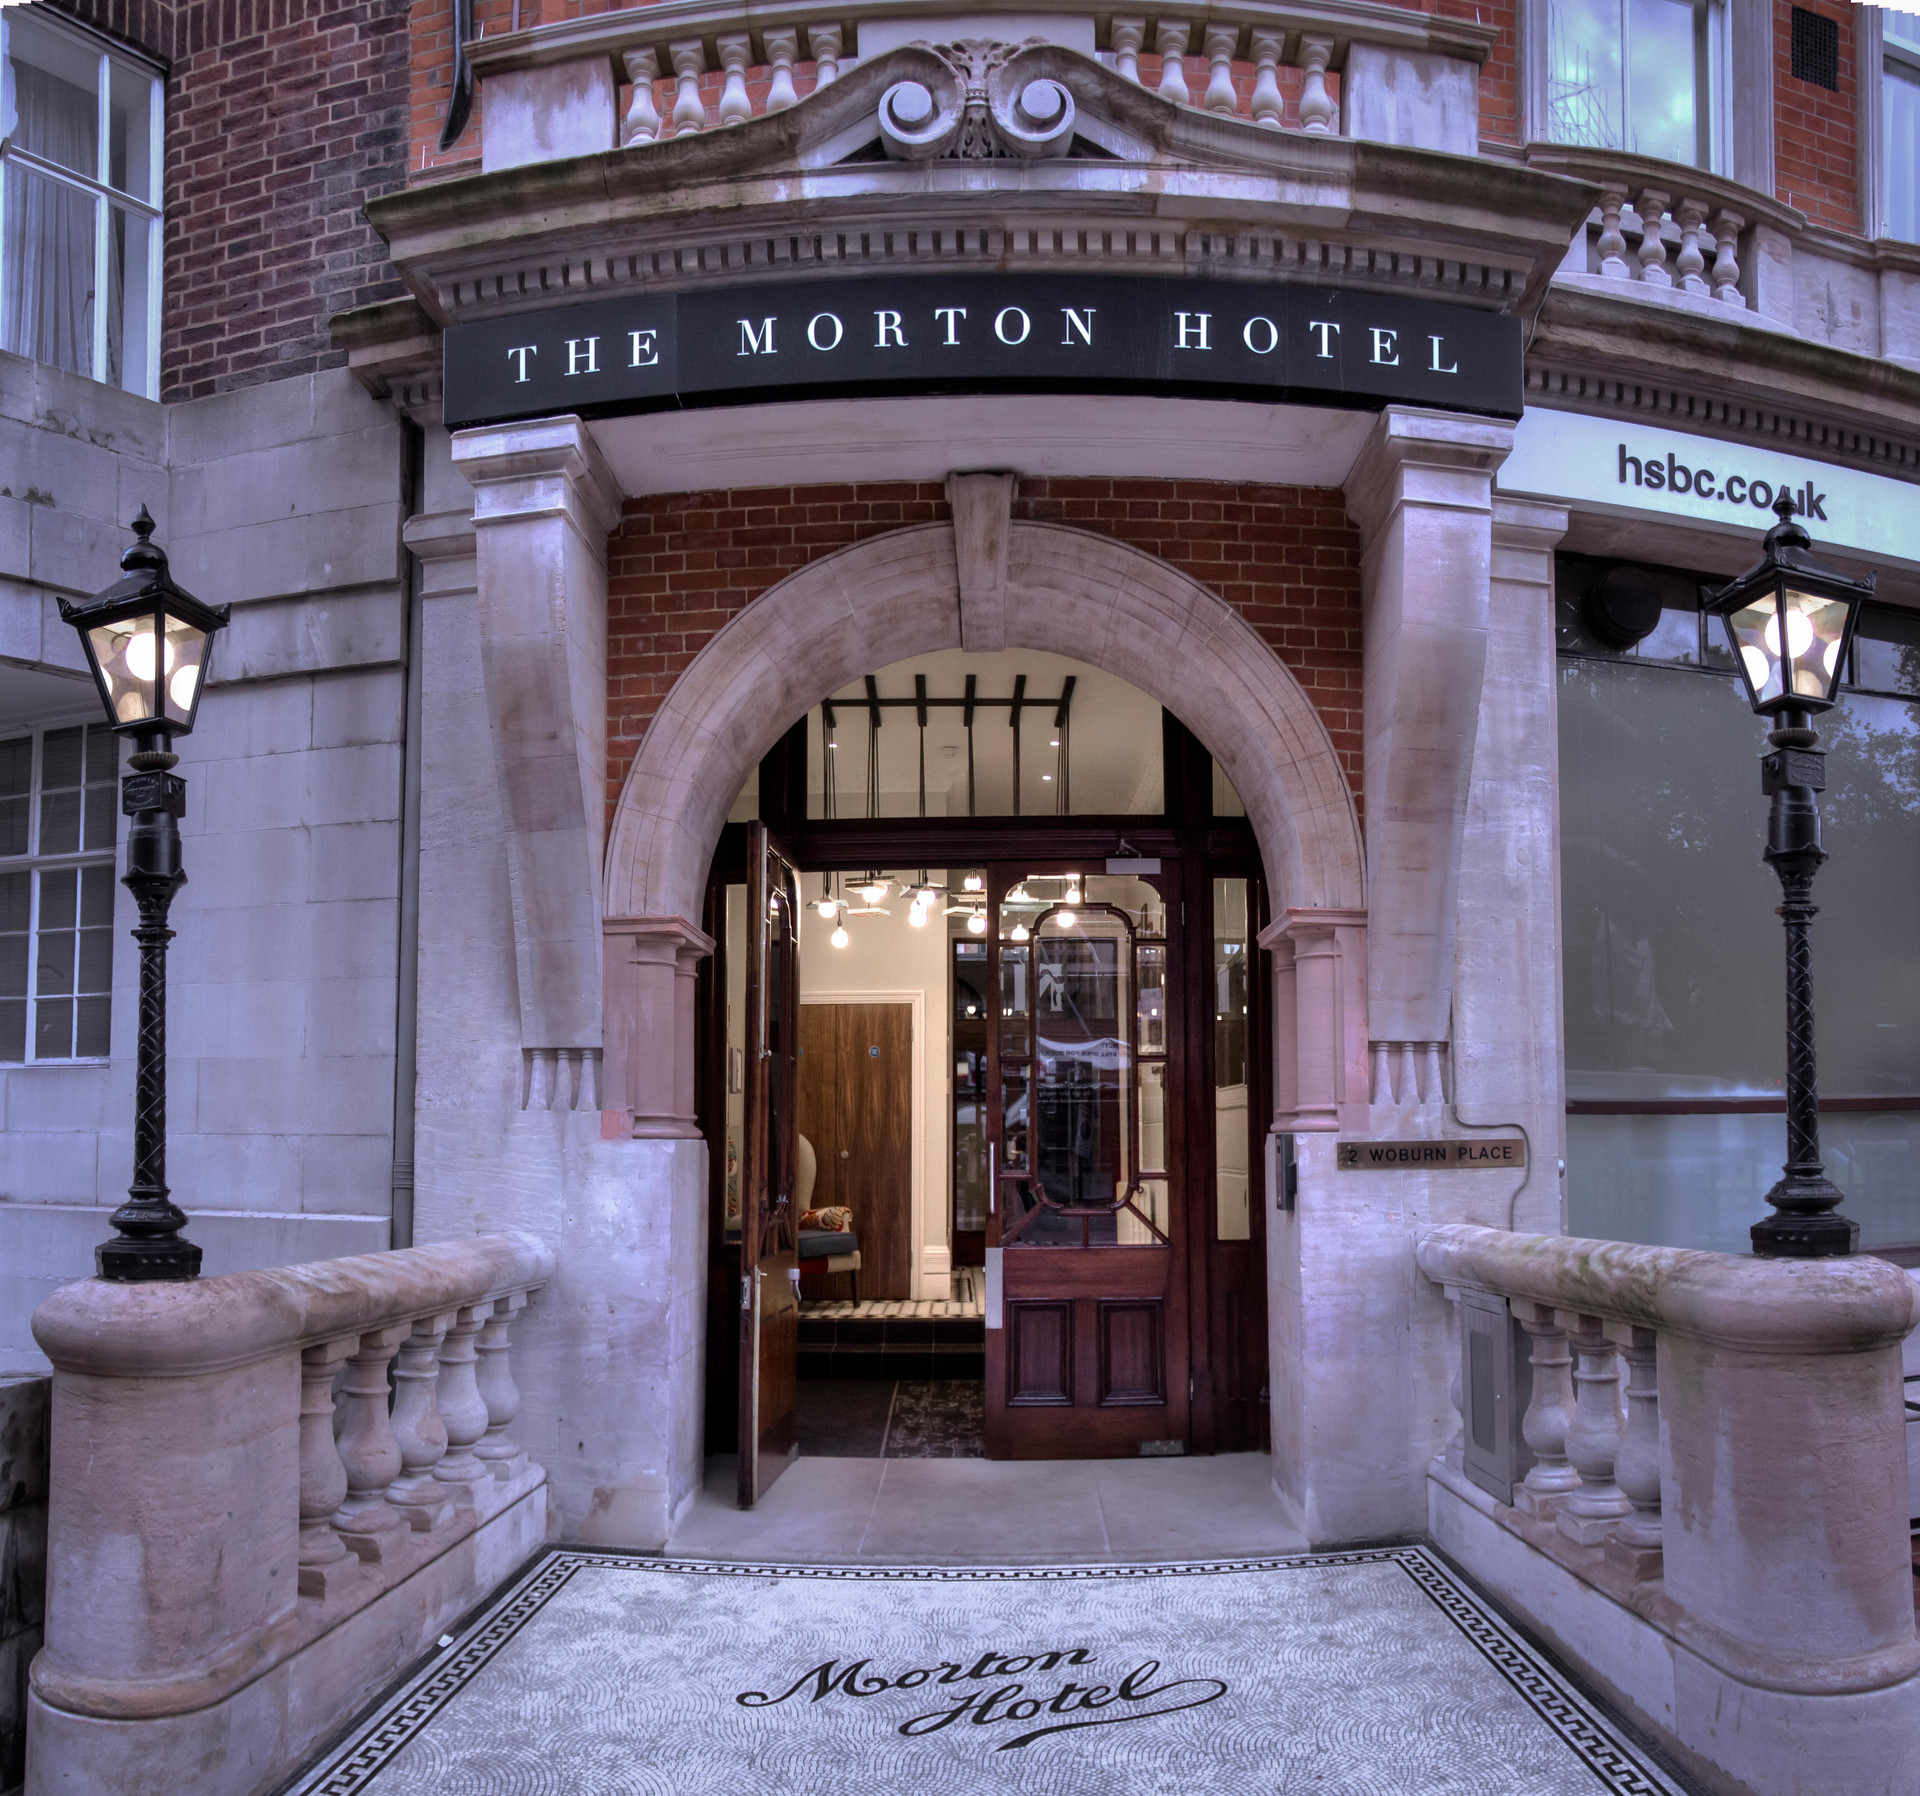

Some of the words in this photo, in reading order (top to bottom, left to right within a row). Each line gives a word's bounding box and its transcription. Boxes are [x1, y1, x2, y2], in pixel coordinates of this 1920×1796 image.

[507, 329, 659, 383] THE
[736, 306, 1097, 356] MORTON
[1174, 312, 1459, 374] HOTEL
[1618, 443, 1828, 521] hsbc.couk
[1348, 1150, 1358, 1162] 2
[1369, 1147, 1447, 1162] WOBURN
[1458, 1146, 1512, 1160] PLACE
[737, 1648, 1098, 1708] Morton
[899, 1660, 1228, 1752] Hotel
